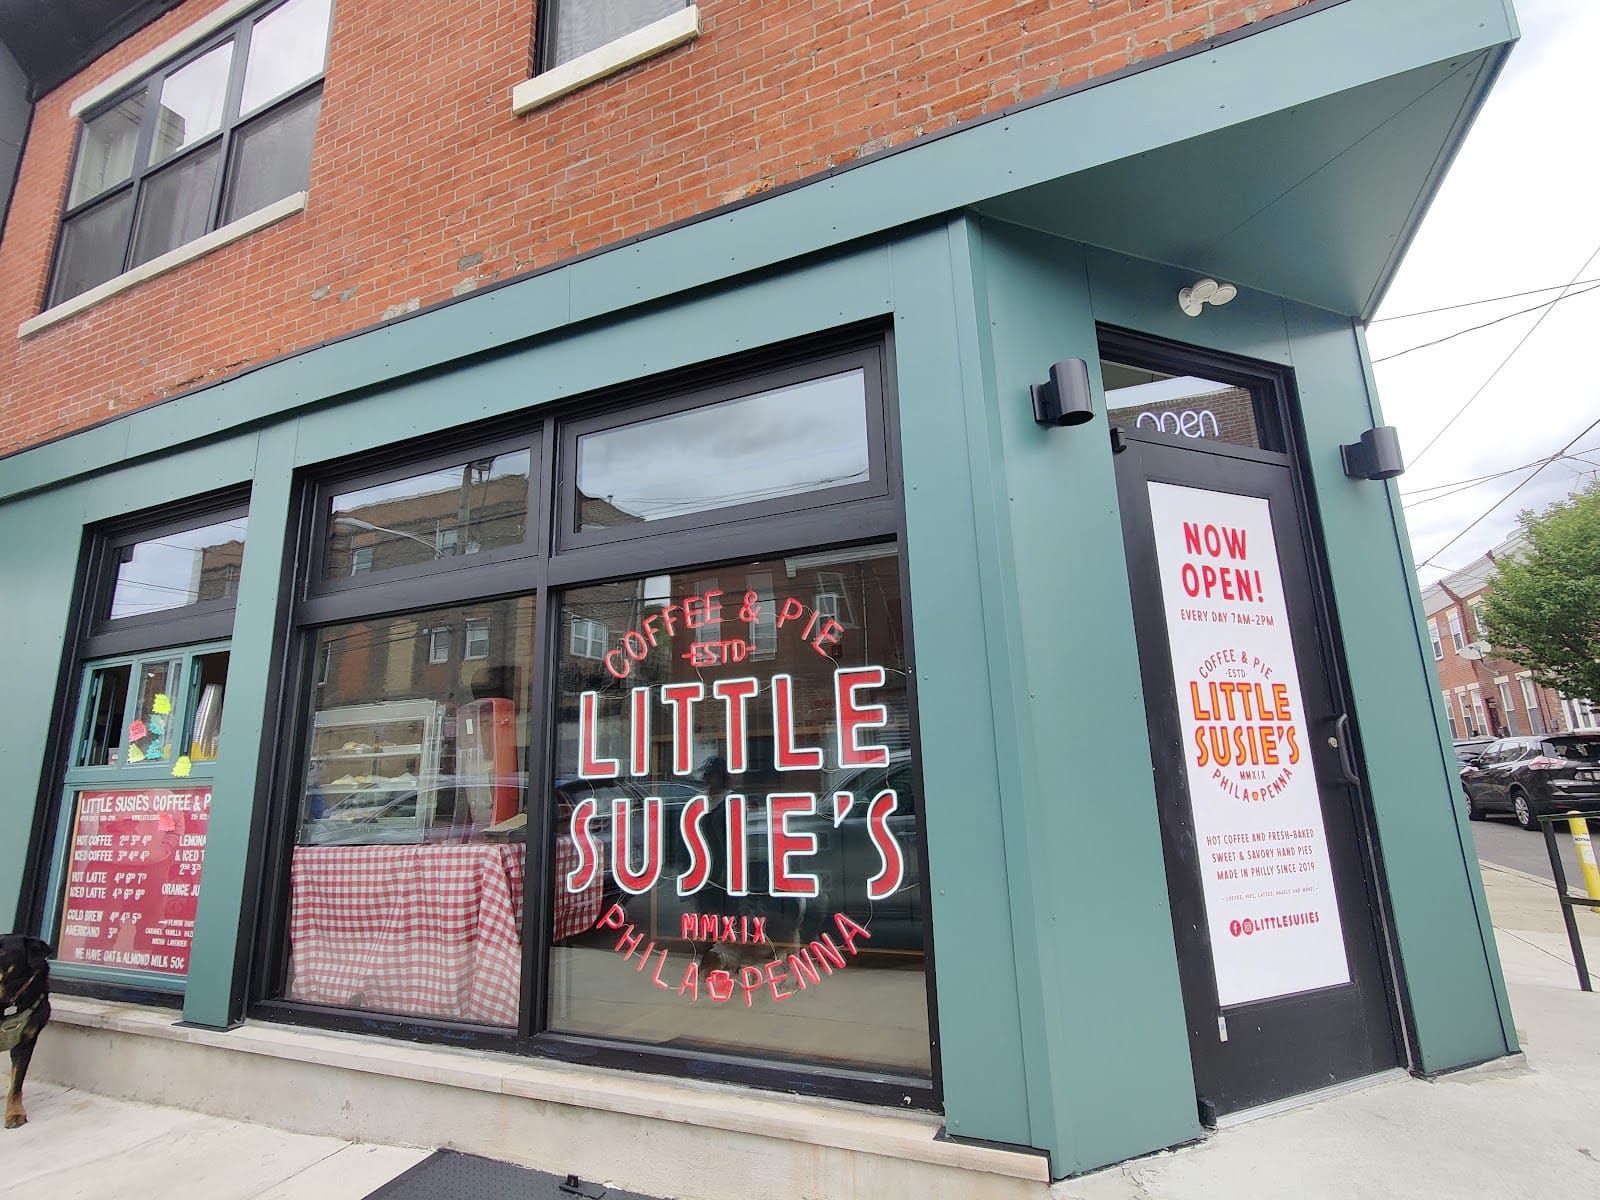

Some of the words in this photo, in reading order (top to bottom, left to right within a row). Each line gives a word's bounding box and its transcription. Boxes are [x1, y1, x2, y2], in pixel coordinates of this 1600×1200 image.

[1183, 521, 1246, 560] NOW
[1181, 563, 1264, 603] OPEN!
[1180, 608, 1208, 622] EVERY
[1211, 611, 1228, 624] DAY
[1231, 612, 1275, 627] 7AM-2PM
[604, 590, 724, 679] COFFEE
[738, 590, 761, 624] &
[776, 597, 846, 657] PIE
[1199, 649, 1236, 679] COFFEE
[1241, 651, 1248, 664] &
[1253, 656, 1273, 680] PIE
[1189, 681, 1292, 721] LITTLE
[578, 666, 890, 780] LITTLE
[1195, 725, 1300, 767] SUSIE'S
[1212, 768, 1250, 802] PHILA
[1260, 767, 1293, 802] PENNA
[1240, 771, 1266, 780] MMXIX
[81, 796, 113, 814] LITTLE
[153, 794, 192, 811] COFFEE
[193, 795, 201, 811] &
[203, 793, 211, 810] P
[76, 835, 88, 846] HOT
[88, 835, 113, 846] COFFEE
[566, 789, 904, 900] SUSIE'S
[1206, 835, 1220, 846] HOT
[1223, 833, 1249, 845] COFFEE
[1252, 832, 1266, 842] AND
[1268, 828, 1315, 841] FRESH-BAKED
[75, 850, 88, 861] ICED
[88, 850, 113, 861] COFFEE
[174, 850, 180, 861] &
[182, 850, 199, 862] ICED
[1212, 851, 1236, 863] SWEET
[1239, 851, 1245, 861] &
[1247, 848, 1274, 860] SAVORY
[1276, 846, 1296, 857] HAND
[1297, 845, 1313, 855] PIES
[72, 872, 84, 882] HOT
[86, 872, 107, 883] LATTE
[1216, 868, 1239, 880] MADE
[1240, 868, 1249, 878] IN
[1251, 865, 1274, 878] PHILLY
[1276, 863, 1297, 875] SINCE
[1299, 861, 1315, 872] 2019
[69, 886, 84, 897] ICED
[85, 887, 107, 898] LATTE
[161, 883, 190, 896] ORANGE
[190, 884, 200, 896] JU
[67, 909, 83, 920] COLD
[84, 910, 104, 922] BREW
[1254, 911, 1320, 931] LITTLESUSIES
[65, 925, 100, 938] AMERICANO
[682, 913, 766, 944] MMXIX
[75, 948, 85, 959] WE
[85, 949, 102, 961] HAVE
[103, 950, 115, 962] OAT
[121, 952, 150, 966] ALMOND
[150, 955, 168, 968] MILK
[597, 904, 699, 1001] PHILA
[741, 913, 871, 1008] PENNA
